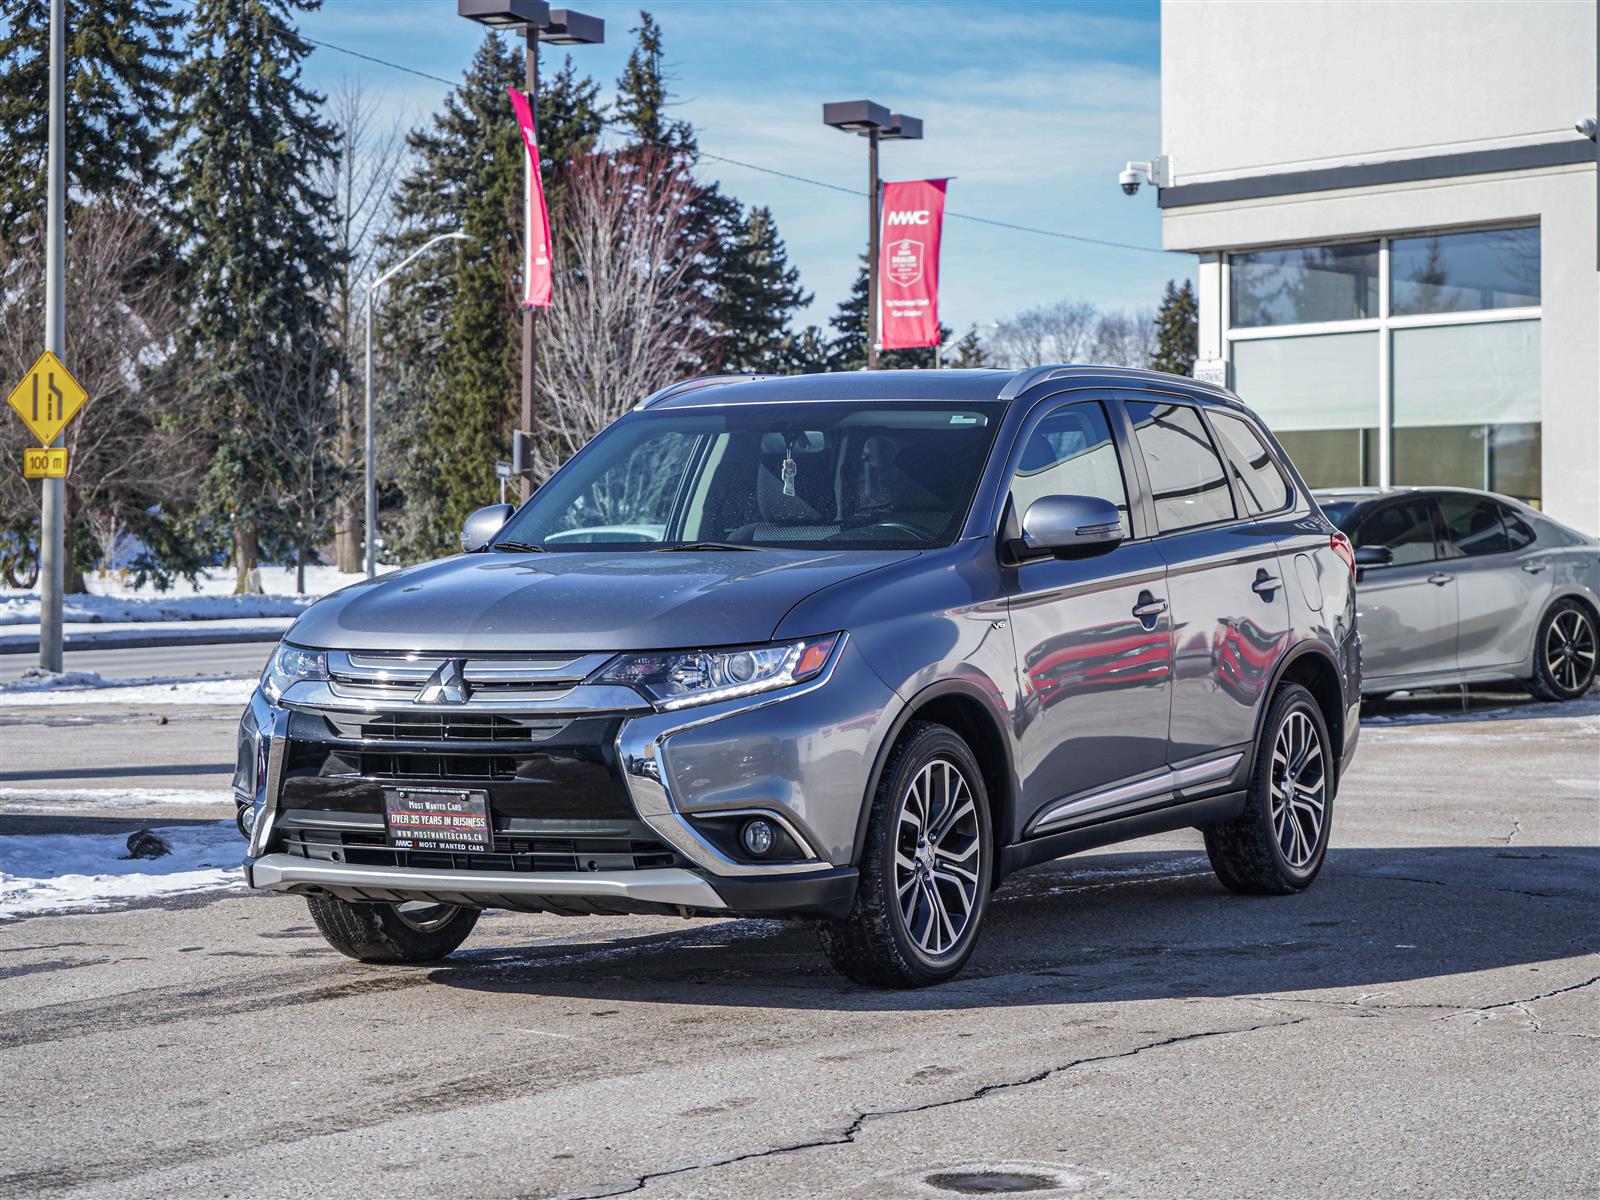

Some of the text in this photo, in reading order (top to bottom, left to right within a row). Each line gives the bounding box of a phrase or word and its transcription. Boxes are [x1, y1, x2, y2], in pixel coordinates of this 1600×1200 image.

[887, 210, 930, 226] MWC
[30, 456, 62, 469] 100 m
[991, 621, 1006, 630] V6
[391, 815, 485, 827] OVER 35 YEARS IN BUSINESS
[439, 843, 466, 851] WANTED
[468, 844, 485, 852] CARS
